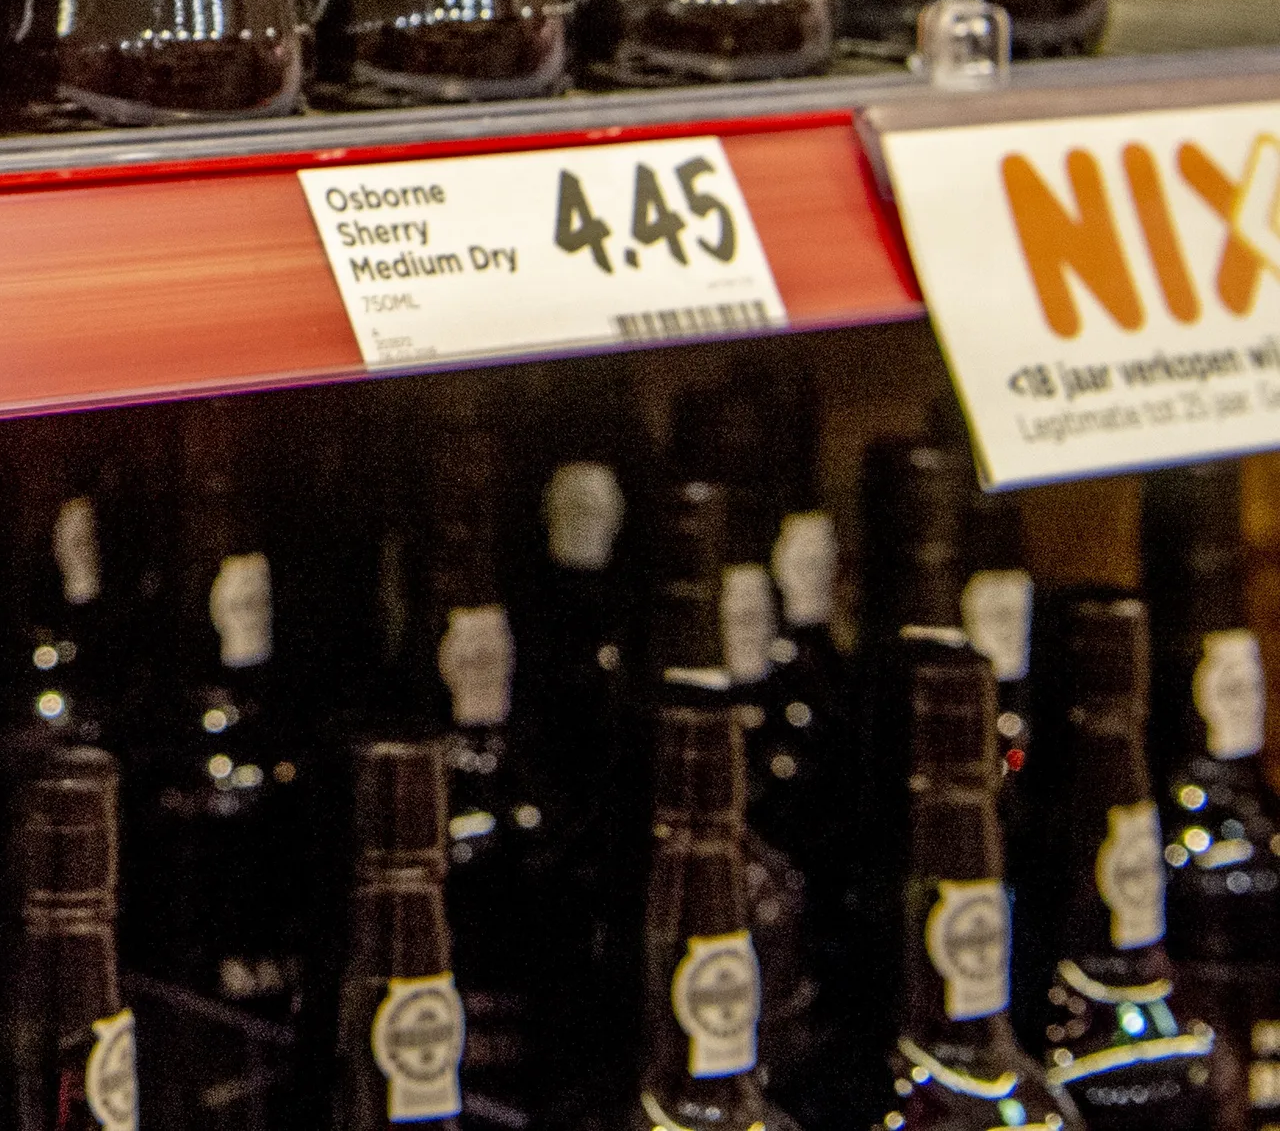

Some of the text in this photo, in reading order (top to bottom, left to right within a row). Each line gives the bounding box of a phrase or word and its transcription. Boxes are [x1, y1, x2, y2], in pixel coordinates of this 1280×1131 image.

[325, 182, 446, 214] Osborne
[555, 155, 739, 275] 4.45
[336, 220, 430, 249] Sherry
[348, 243, 519, 284] Medium Dry
